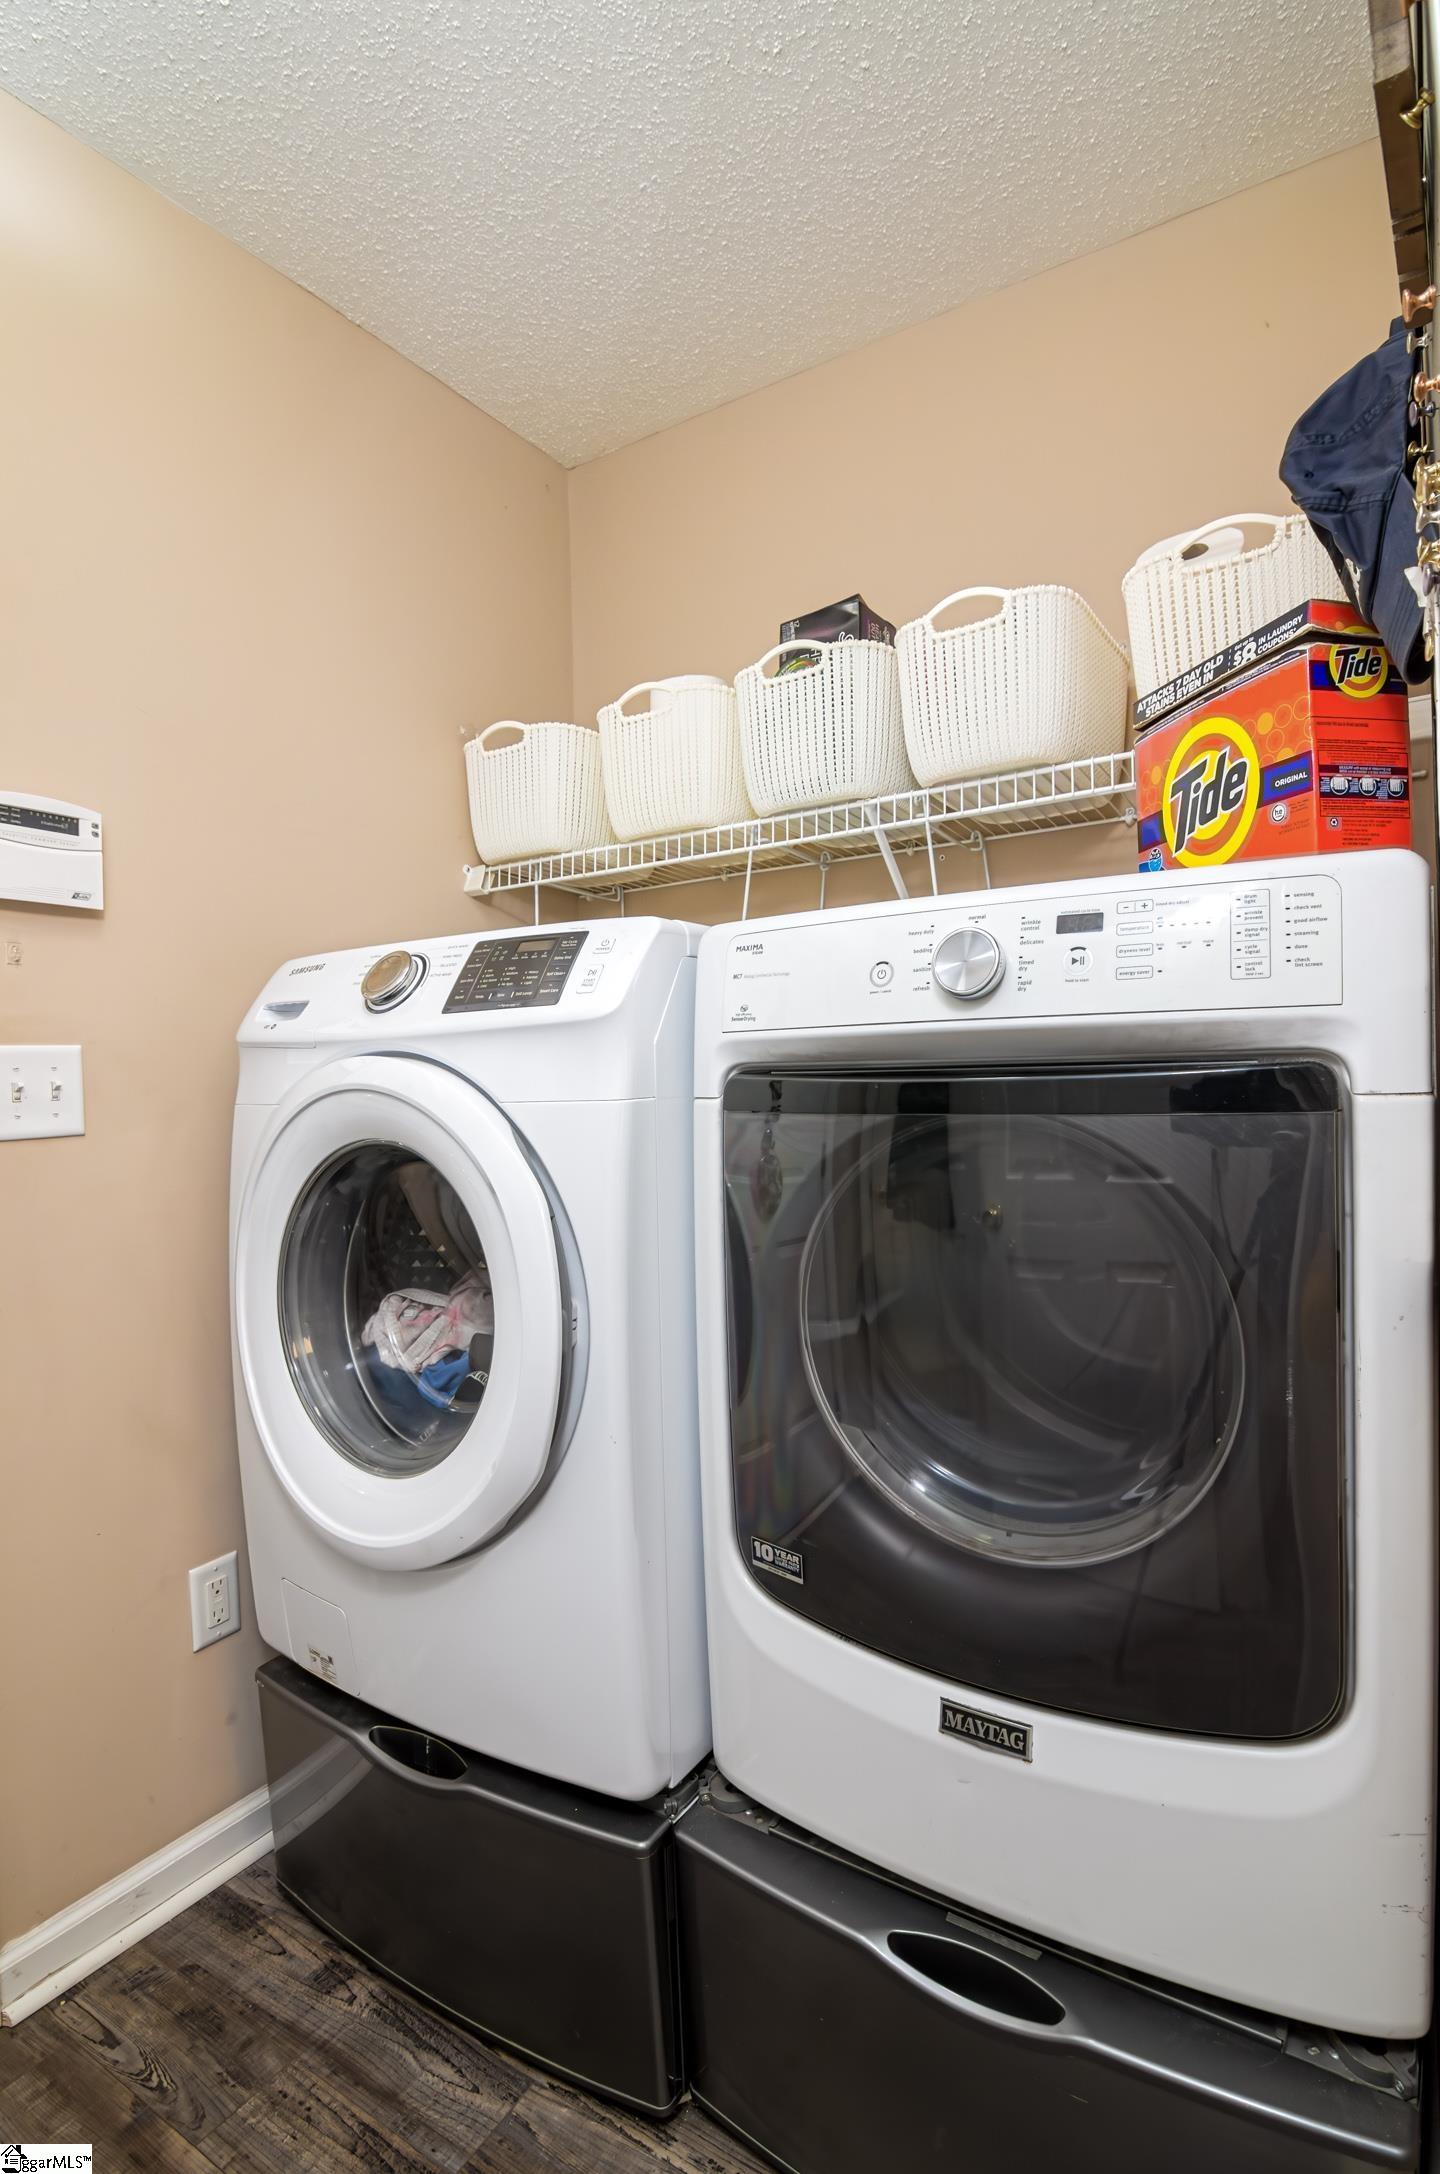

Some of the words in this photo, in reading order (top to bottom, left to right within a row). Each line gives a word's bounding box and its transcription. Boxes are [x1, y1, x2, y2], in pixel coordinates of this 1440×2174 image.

[1258, 636, 1266, 646] IN
[1267, 614, 1303, 640] LAUNDRY
[1233, 641, 1257, 666] $8
[1334, 647, 1383, 686] Tide
[1136, 686, 1174, 714] ATTACKS
[1175, 678, 1183, 690] 7
[1182, 667, 1202, 687] DAY
[1203, 654, 1224, 672] OLD
[1145, 693, 1176, 718] STAINS
[1176, 678, 1202, 702] EVEN
[1202, 670, 1214, 686] IN
[1274, 771, 1308, 788] ORIGINAL
[1169, 746, 1249, 858] Tide
[736, 944, 764, 952] MAXIMA
[289, 962, 326, 976] SAMSUNG
[754, 1540, 774, 1562] 10
[774, 1548, 800, 1564] YEAR
[944, 1709, 1024, 1750] MAYTAG
